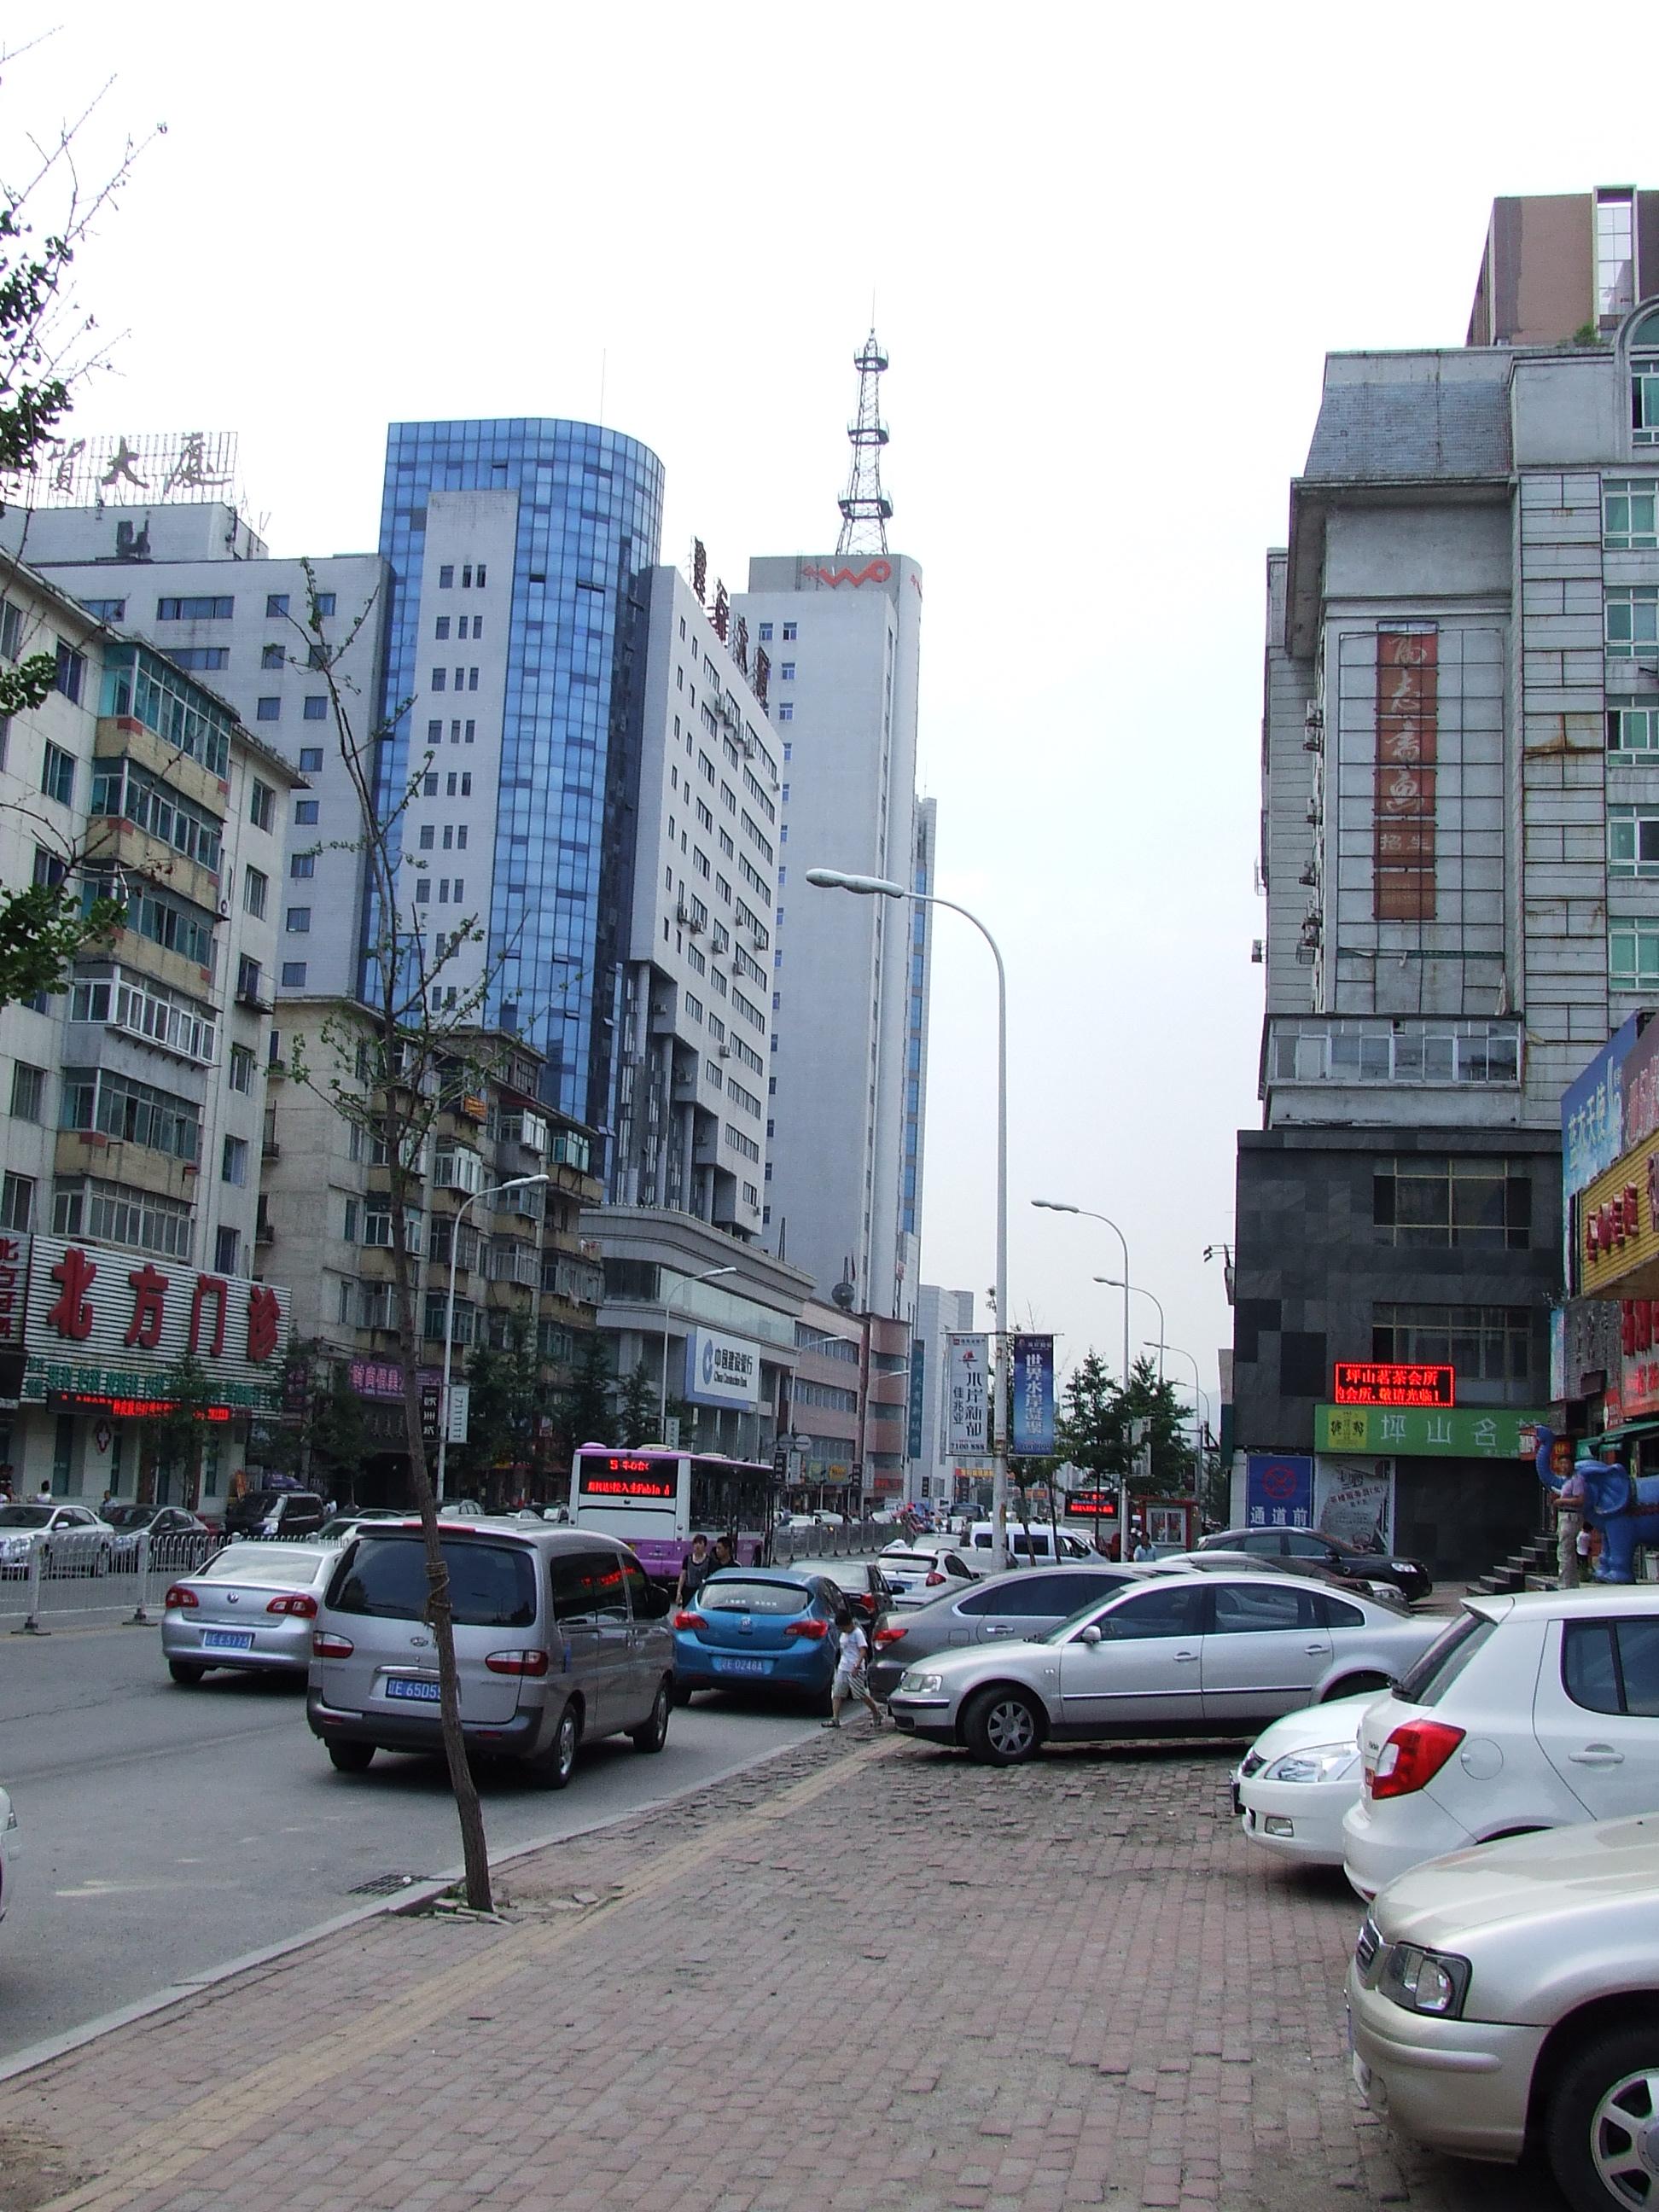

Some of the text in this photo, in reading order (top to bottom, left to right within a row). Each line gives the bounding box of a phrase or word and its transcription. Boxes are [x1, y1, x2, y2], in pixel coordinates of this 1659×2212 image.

[1380, 832, 1432, 851] 招生
[47, 1246, 281, 1362] 北方门诊
[714, 1347, 753, 1376] 中国建设银行
[1345, 1368, 1439, 1387] 坪山茗茶会所
[1250, 1505, 1309, 1527] 通道前
